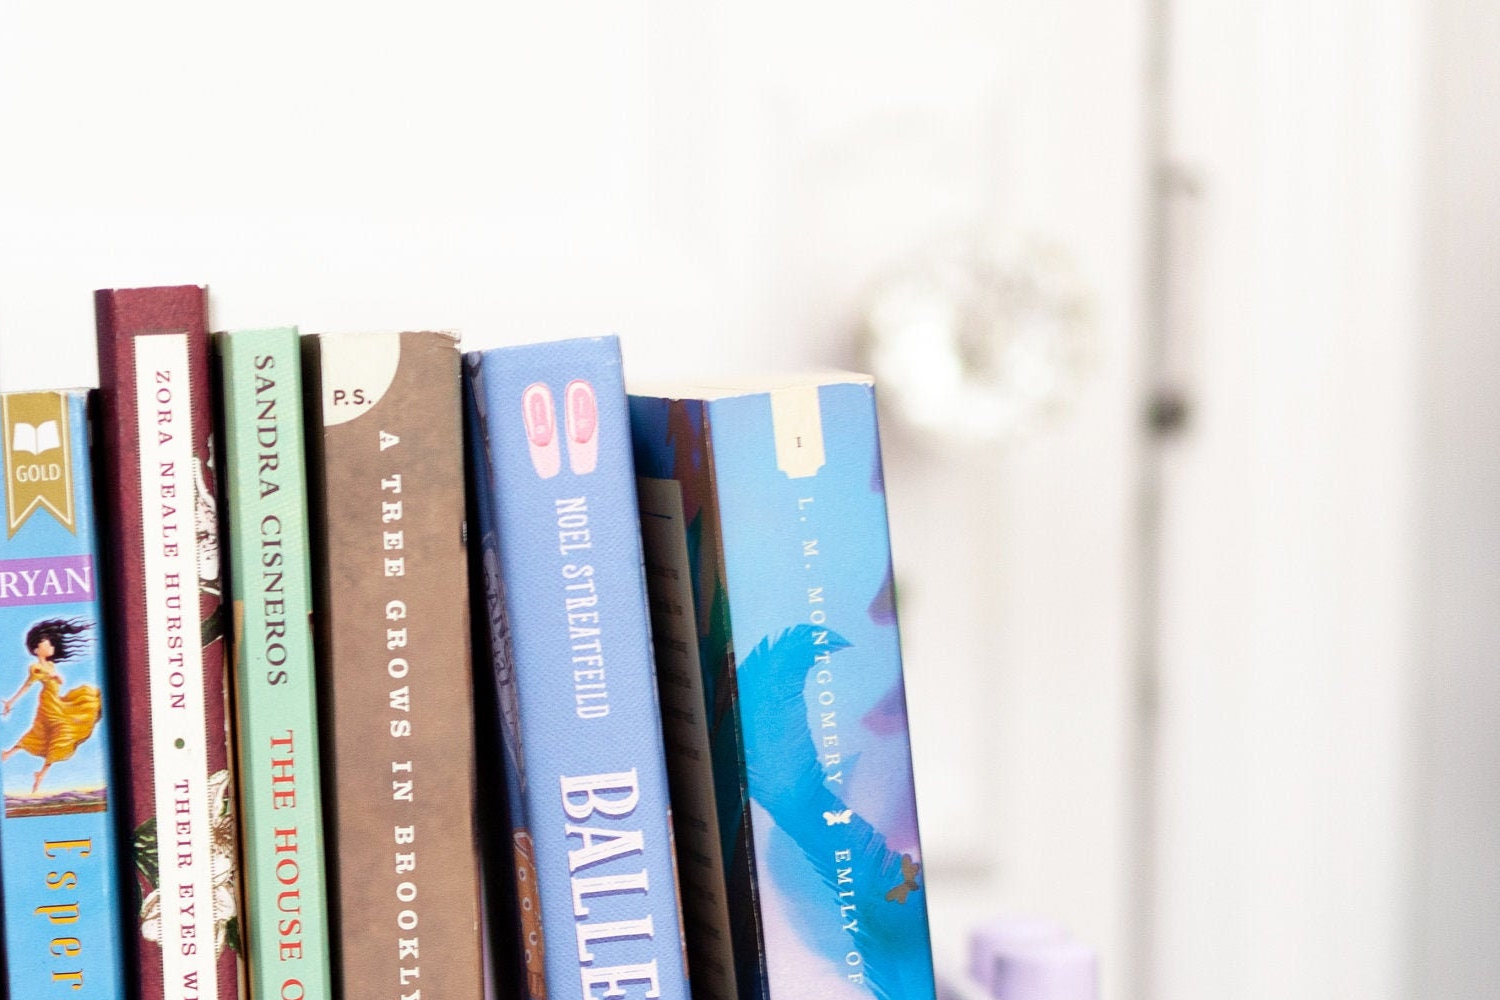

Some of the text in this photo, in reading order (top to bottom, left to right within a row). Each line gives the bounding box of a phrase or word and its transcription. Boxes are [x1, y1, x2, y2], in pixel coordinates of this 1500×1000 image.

[155, 369, 175, 446] ZORA
[253, 353, 281, 501] SANDRA
[332, 388, 373, 406] P.S.
[378, 429, 401, 452] A
[15, 462, 61, 483] GOLD
[159, 461, 180, 558] NEALE
[797, 496, 815, 523] L.
[380, 473, 406, 578] TREE
[801, 538, 821, 571] M.
[163, 571, 187, 711] HURSTON
[259, 514, 289, 686] CISNEROS
[554, 495, 611, 720] NOEL STREATFEILD
[384, 599, 412, 739] GROWS
[807, 586, 845, 786] MONTGOMERY
[269, 728, 297, 811] THE
[390, 760, 414, 803] IN
[173, 778, 194, 870] THEIR
[178, 882, 198, 957] EYES
[273, 826, 304, 963] HOUSE
[833, 848, 860, 935] EMILY
[845, 949, 865, 986] OF
